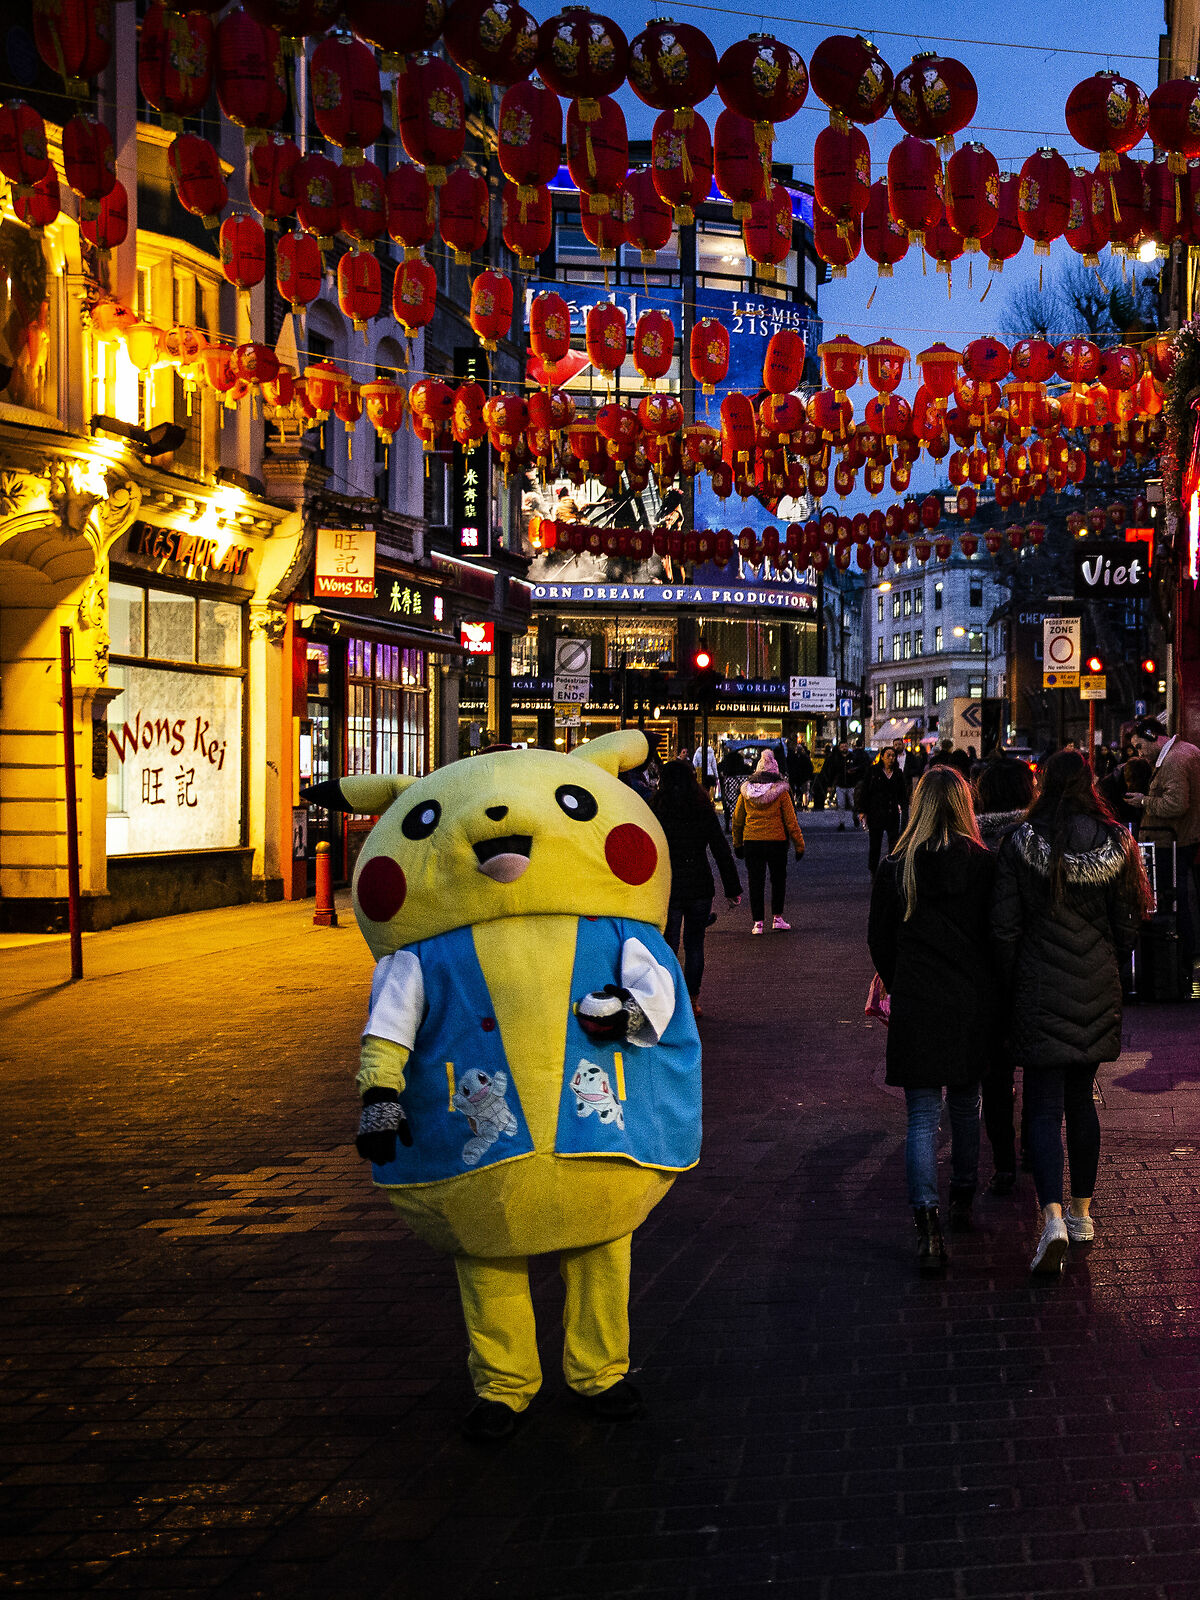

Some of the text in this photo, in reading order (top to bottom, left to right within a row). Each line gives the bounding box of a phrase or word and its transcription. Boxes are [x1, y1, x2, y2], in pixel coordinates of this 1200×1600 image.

[732, 301, 800, 327] LES MIS
[732, 317, 782, 337] 21ST
[137, 523, 254, 575] RESTAURANT
[334, 533, 359, 574] 旺記
[1081, 555, 1141, 586] Viet
[318, 577, 353, 596] Wong
[355, 579, 373, 593] Kei
[583, 587, 645, 599] DREAM
[662, 589, 684, 600] OF
[693, 590, 703, 601] A
[1050, 626, 1073, 634] ZONE
[557, 691, 585, 700] ENDS
[736, 682, 787, 693] WORLD'S
[762, 704, 790, 713] THEATR
[107, 710, 227, 771] Wong Kei
[142, 765, 198, 808] 旺記
